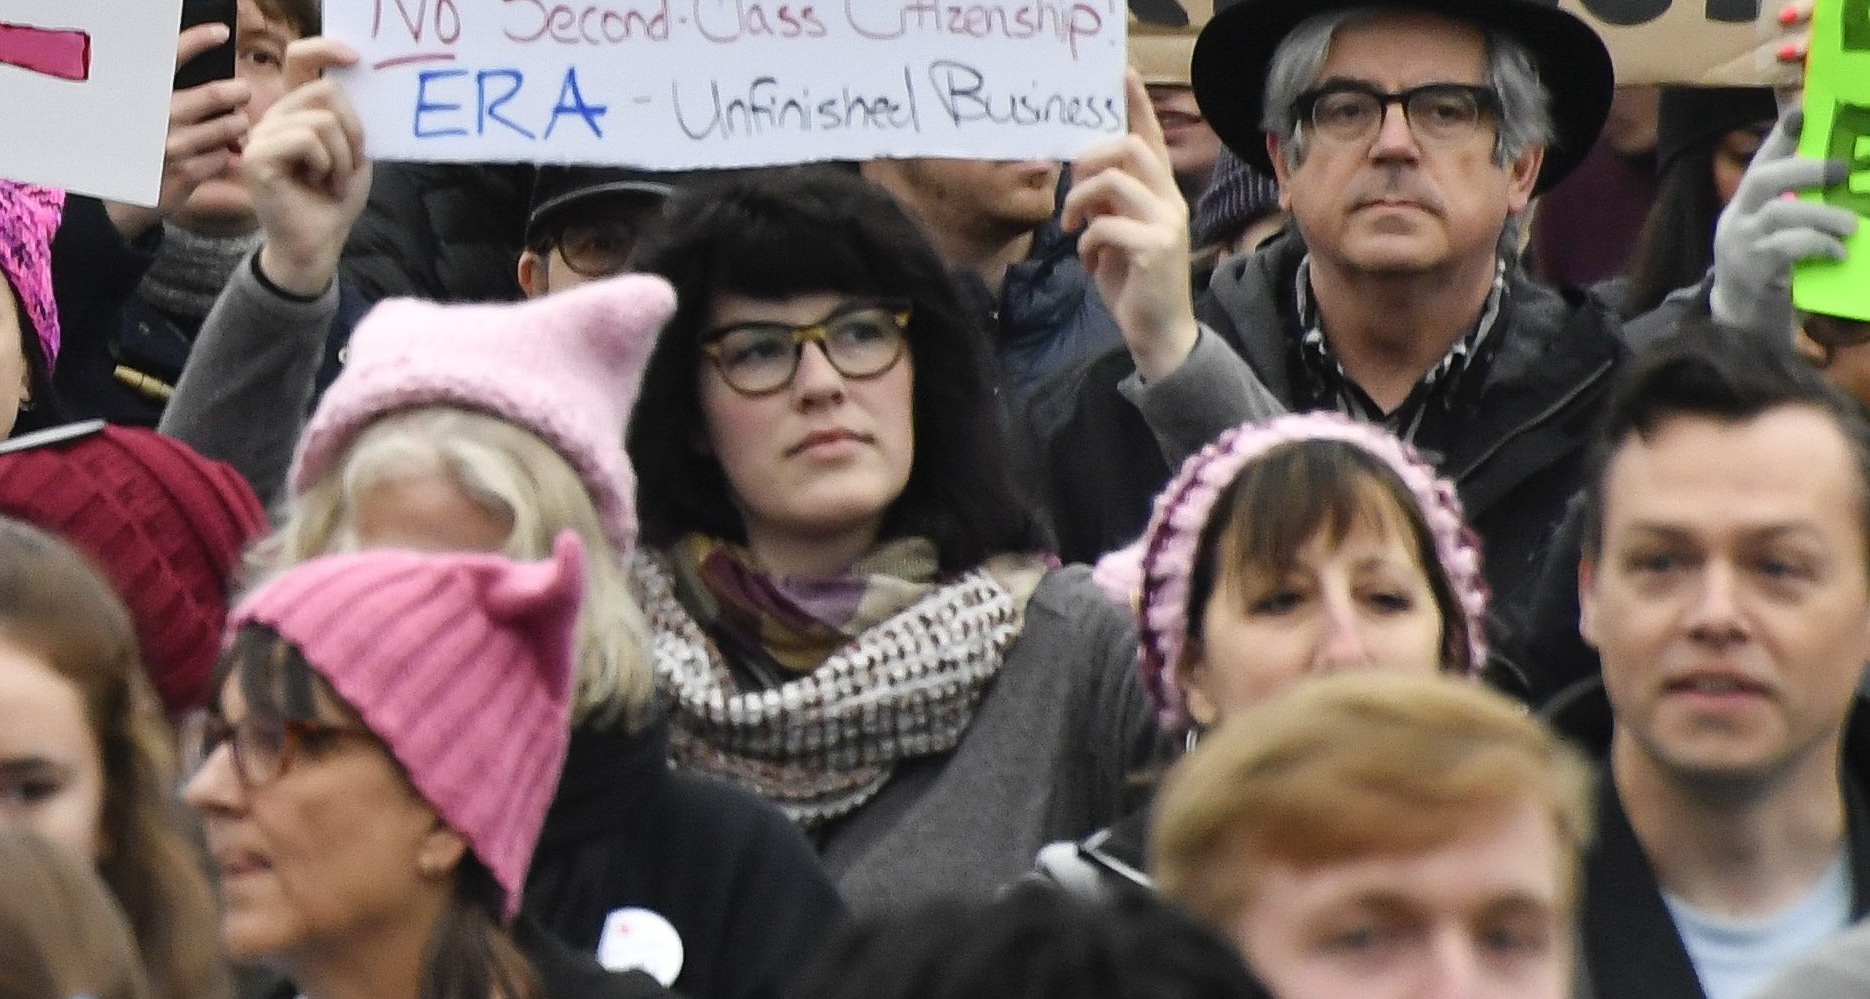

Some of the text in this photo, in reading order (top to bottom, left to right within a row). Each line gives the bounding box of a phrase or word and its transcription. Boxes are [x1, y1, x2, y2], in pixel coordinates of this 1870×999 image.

[413, 65, 609, 141] ERA
[673, 64, 921, 142] Unfinished
[930, 61, 1123, 132] Business
